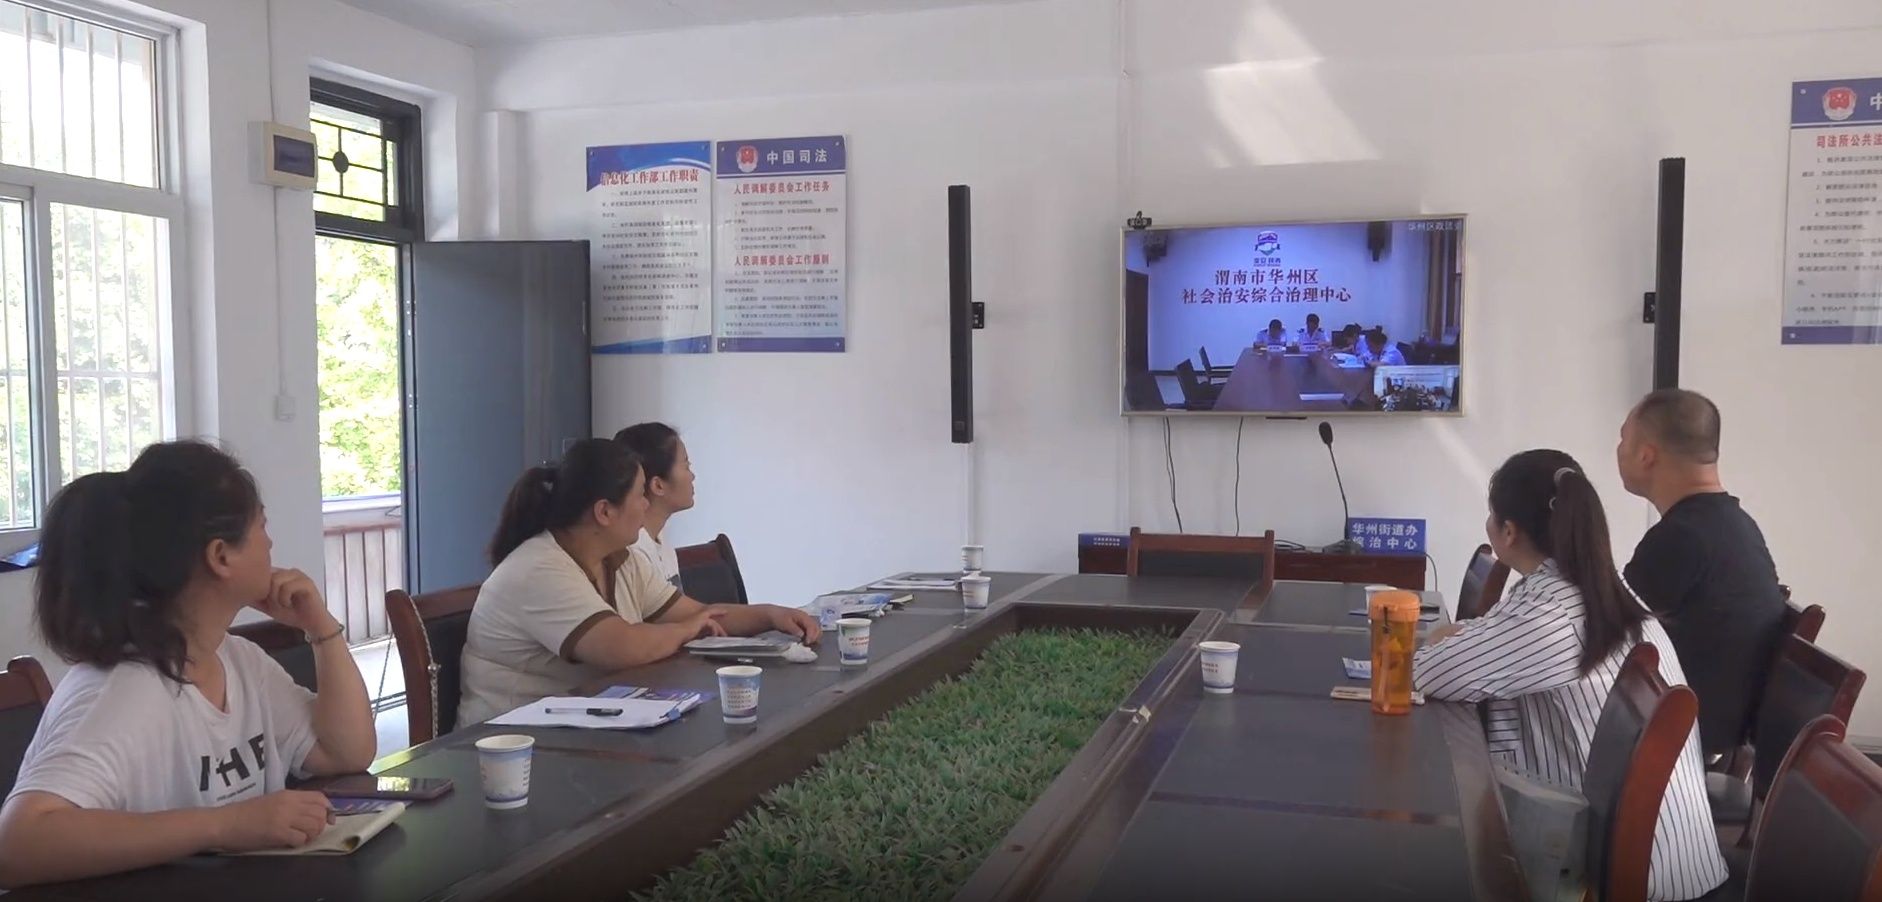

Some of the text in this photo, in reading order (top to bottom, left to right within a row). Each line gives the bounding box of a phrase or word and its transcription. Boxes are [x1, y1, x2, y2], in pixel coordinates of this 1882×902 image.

[767, 149, 827, 165] 中国司法
[600, 169, 700, 186] 信息化工作部工作职责
[734, 181, 830, 195] 人民调解委员会工作任务
[1215, 269, 1319, 286] 渭南市华州区
[1182, 286, 1352, 304] 社会治安综合治理中心
[1352, 523, 1418, 536] 华州街道办
